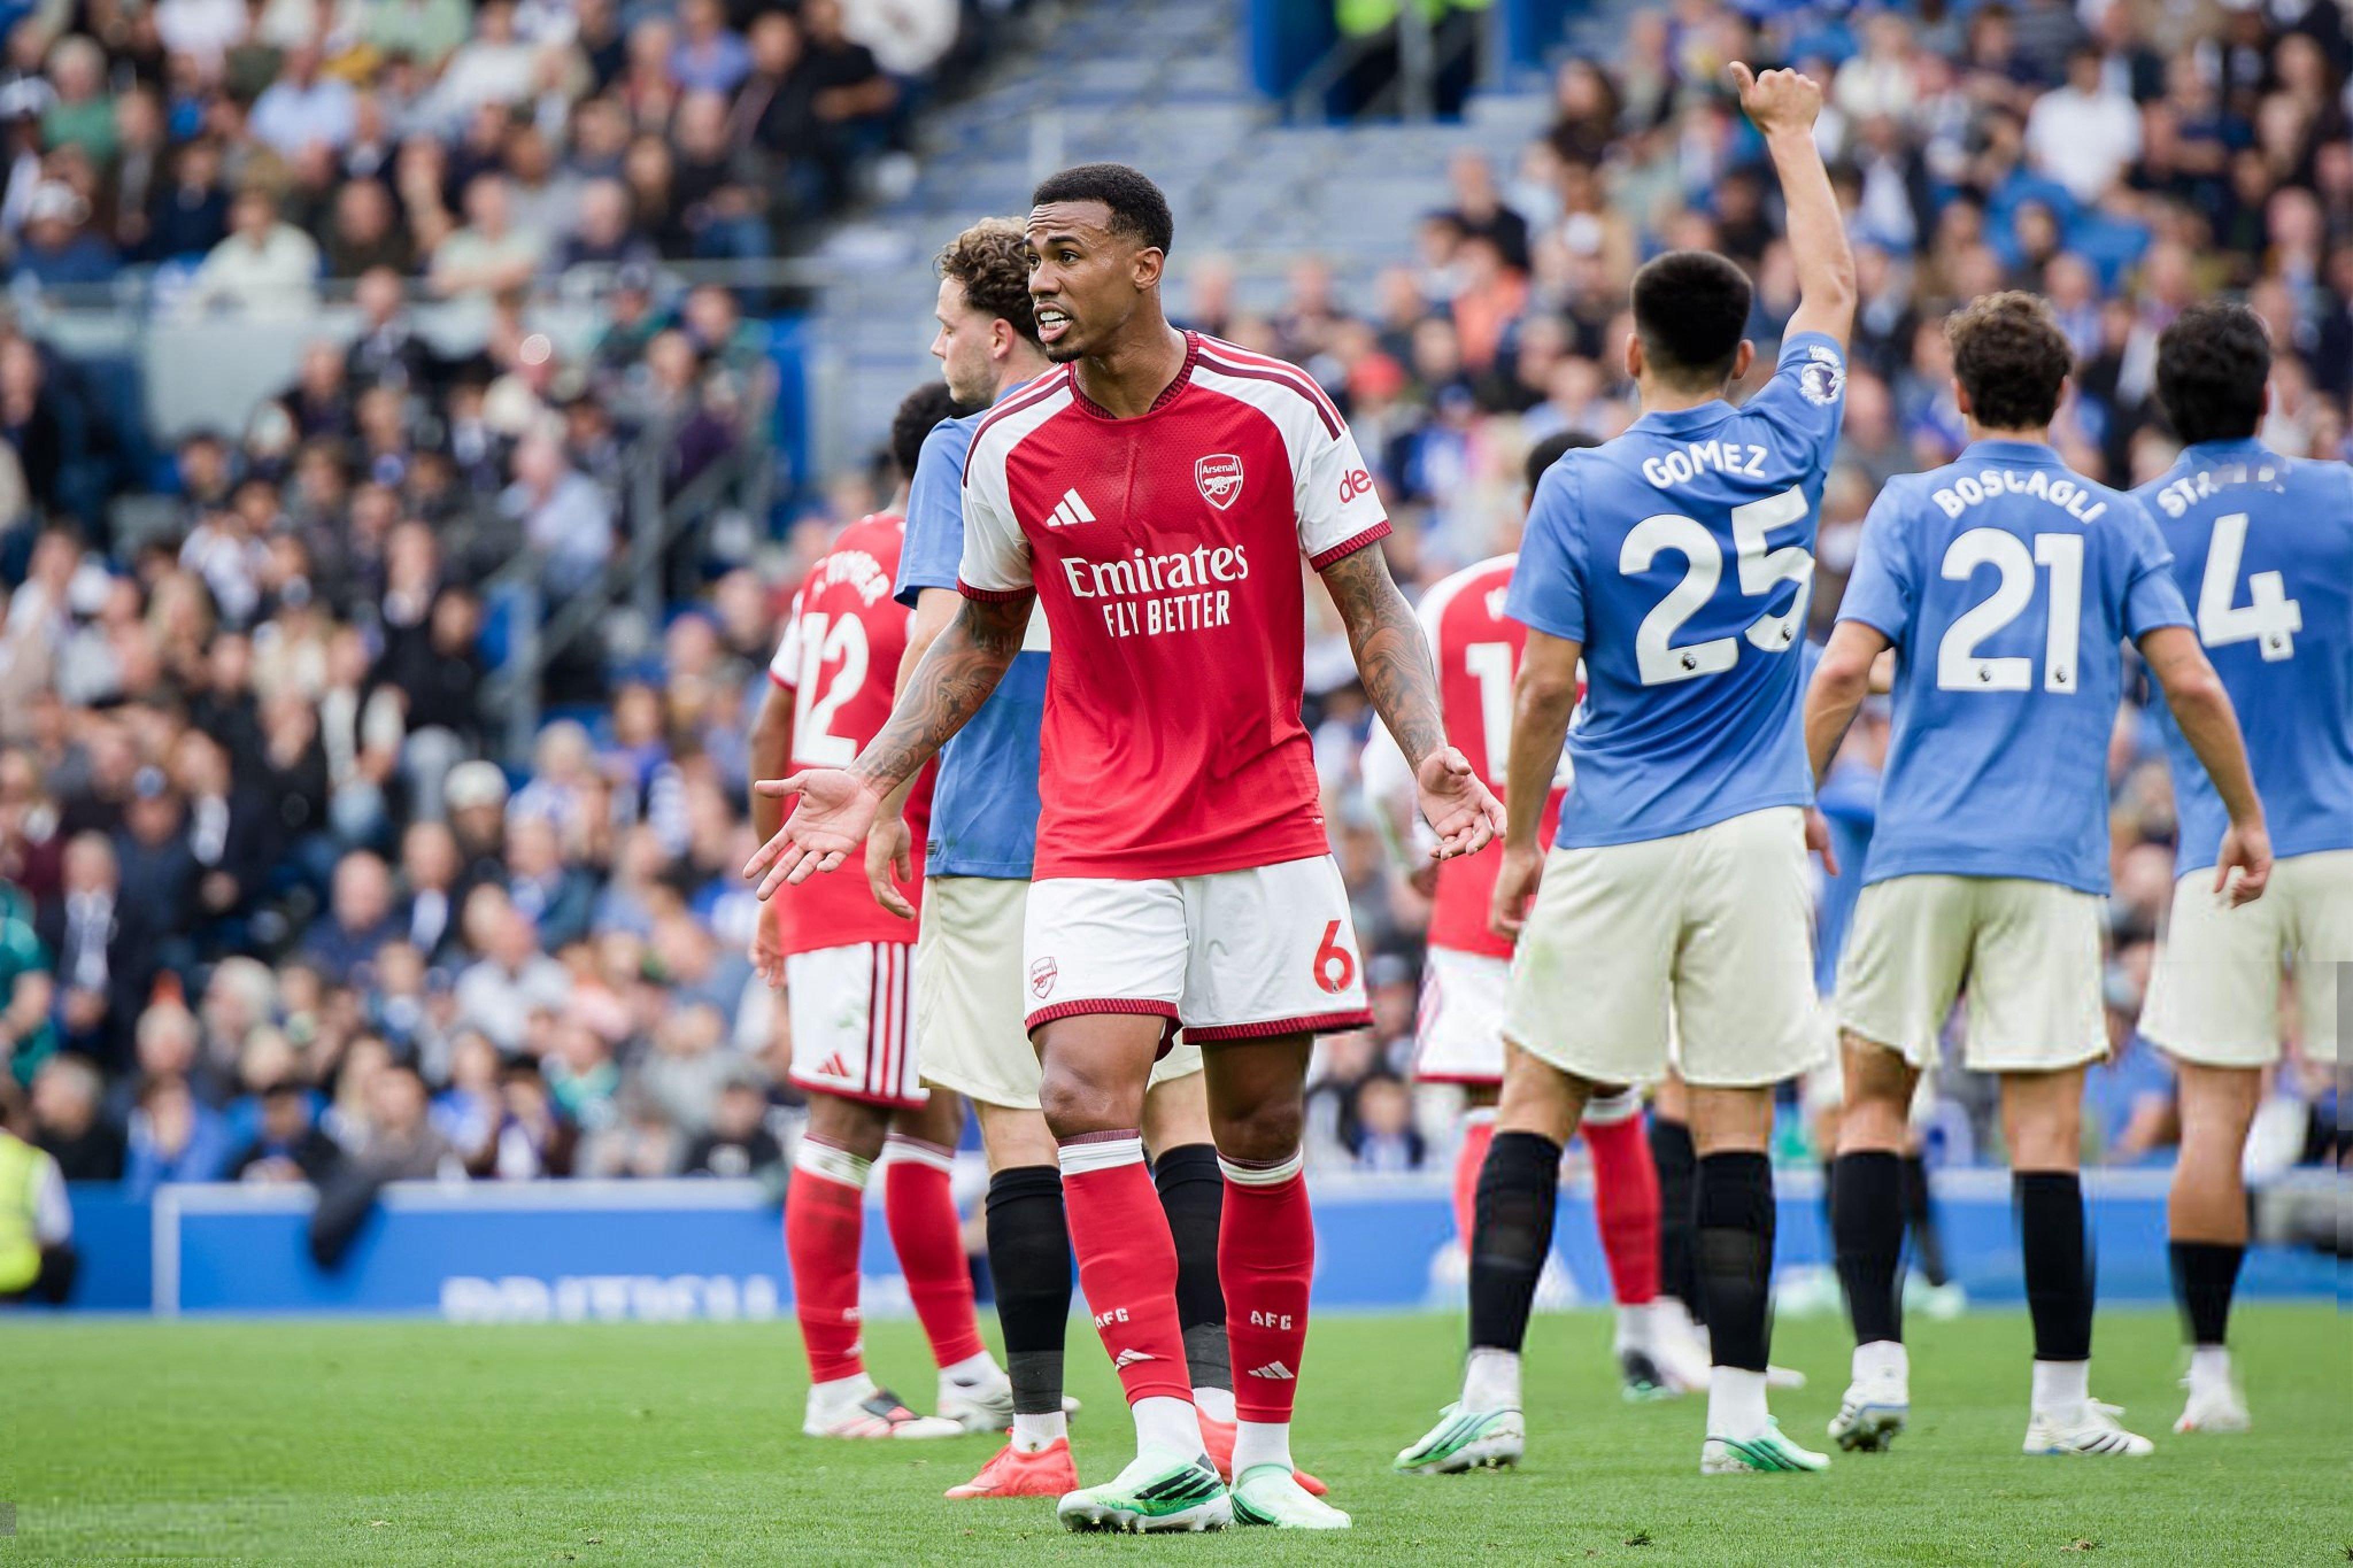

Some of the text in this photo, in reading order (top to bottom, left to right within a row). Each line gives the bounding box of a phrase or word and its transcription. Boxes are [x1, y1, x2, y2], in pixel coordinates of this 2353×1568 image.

[1203, 463, 1235, 474] Arsenal
[1642, 440, 1768, 489] GOMEZ
[1060, 543, 1248, 597] Emirates
[1619, 484, 1815, 686] 25
[2197, 512, 2302, 662] 4
[1103, 590, 1230, 637] FLY BETTER
[1937, 527, 2084, 693] 21
[791, 612, 869, 770] 12
[1313, 920, 1355, 994] 6
[1251, 1310, 1291, 1330] AFC
